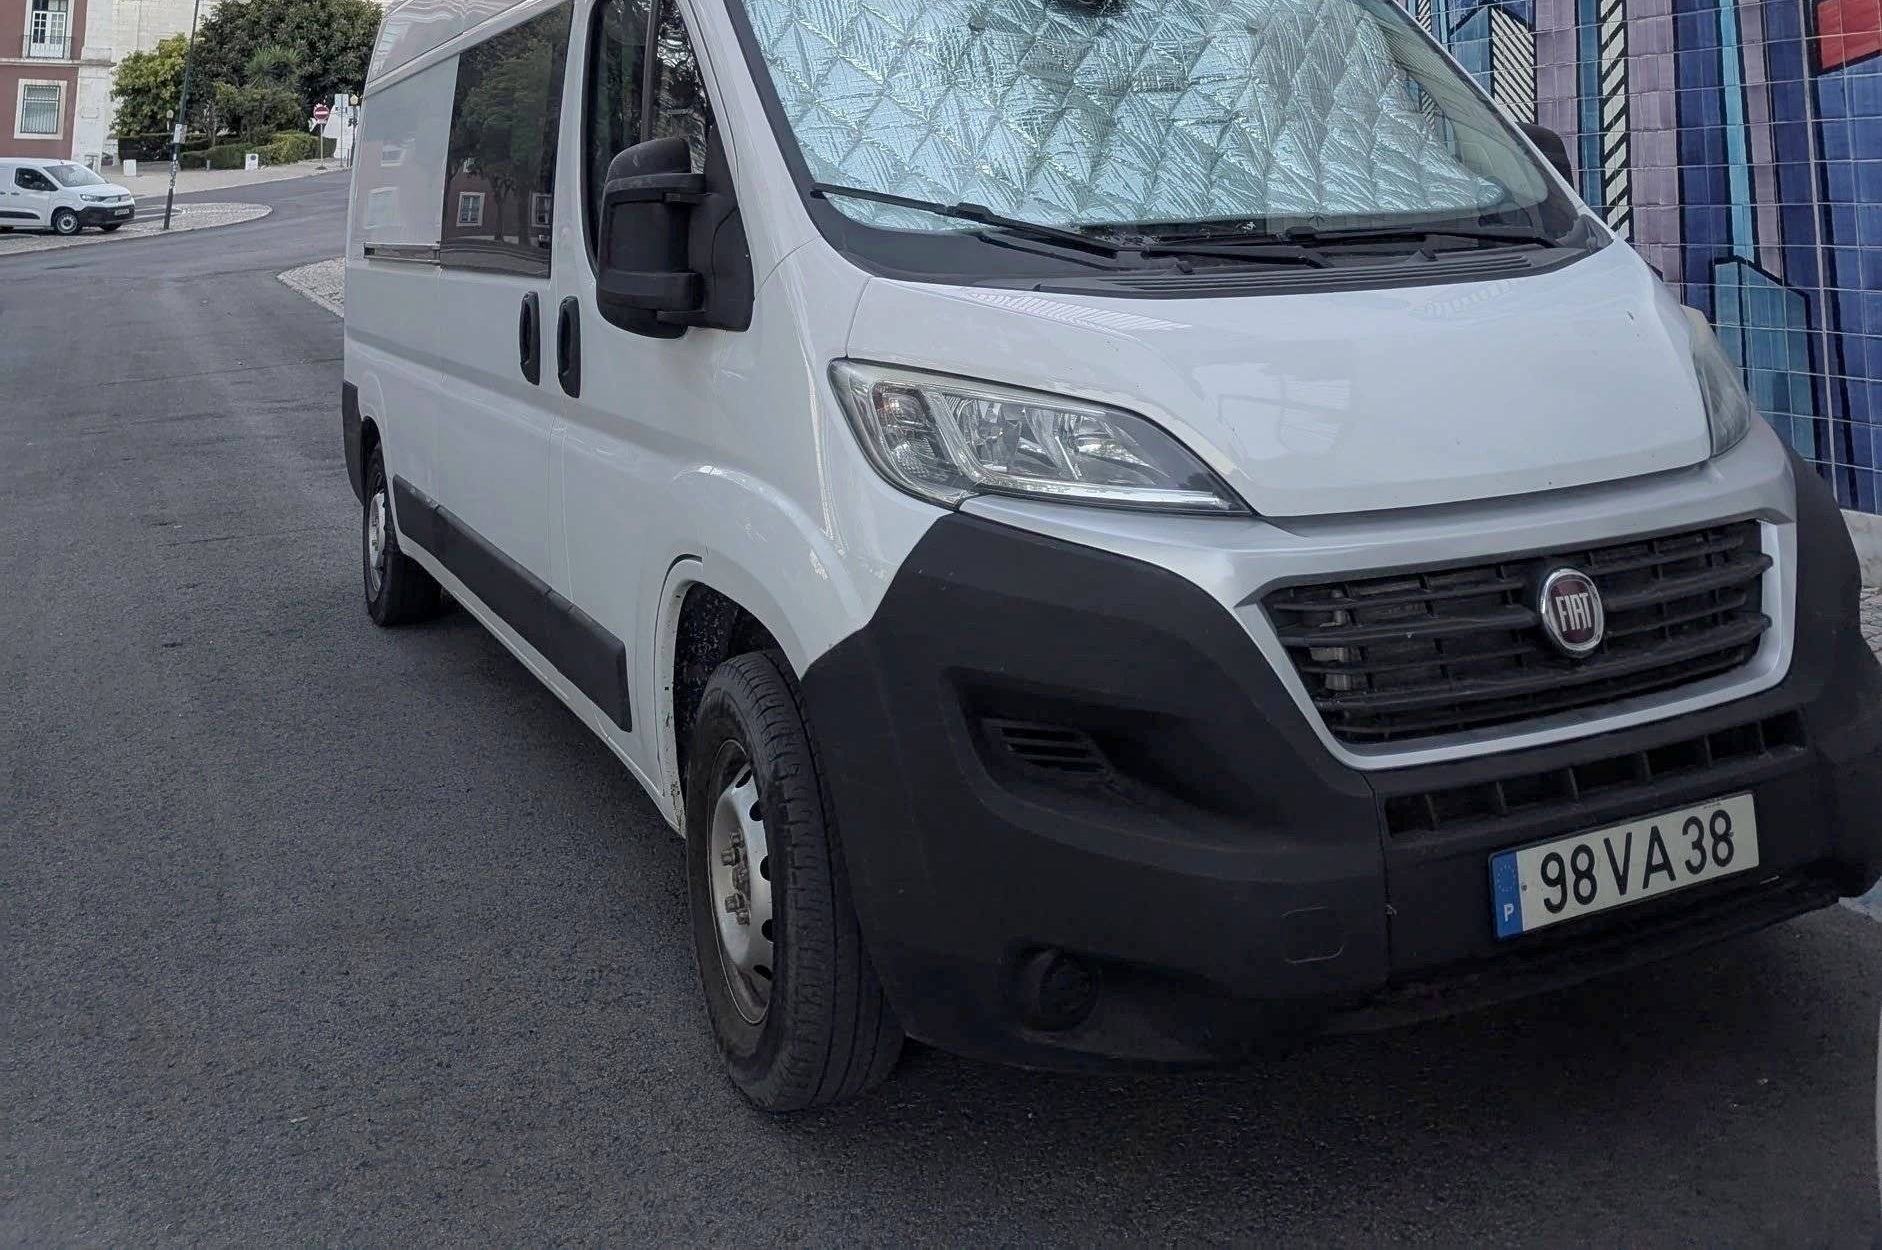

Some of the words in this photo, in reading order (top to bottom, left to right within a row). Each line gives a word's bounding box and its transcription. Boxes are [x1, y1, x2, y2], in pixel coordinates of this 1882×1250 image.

[1555, 592, 1592, 632] FIAT
[1540, 810, 1735, 914] 98VA38
[1503, 903, 1515, 922] P
